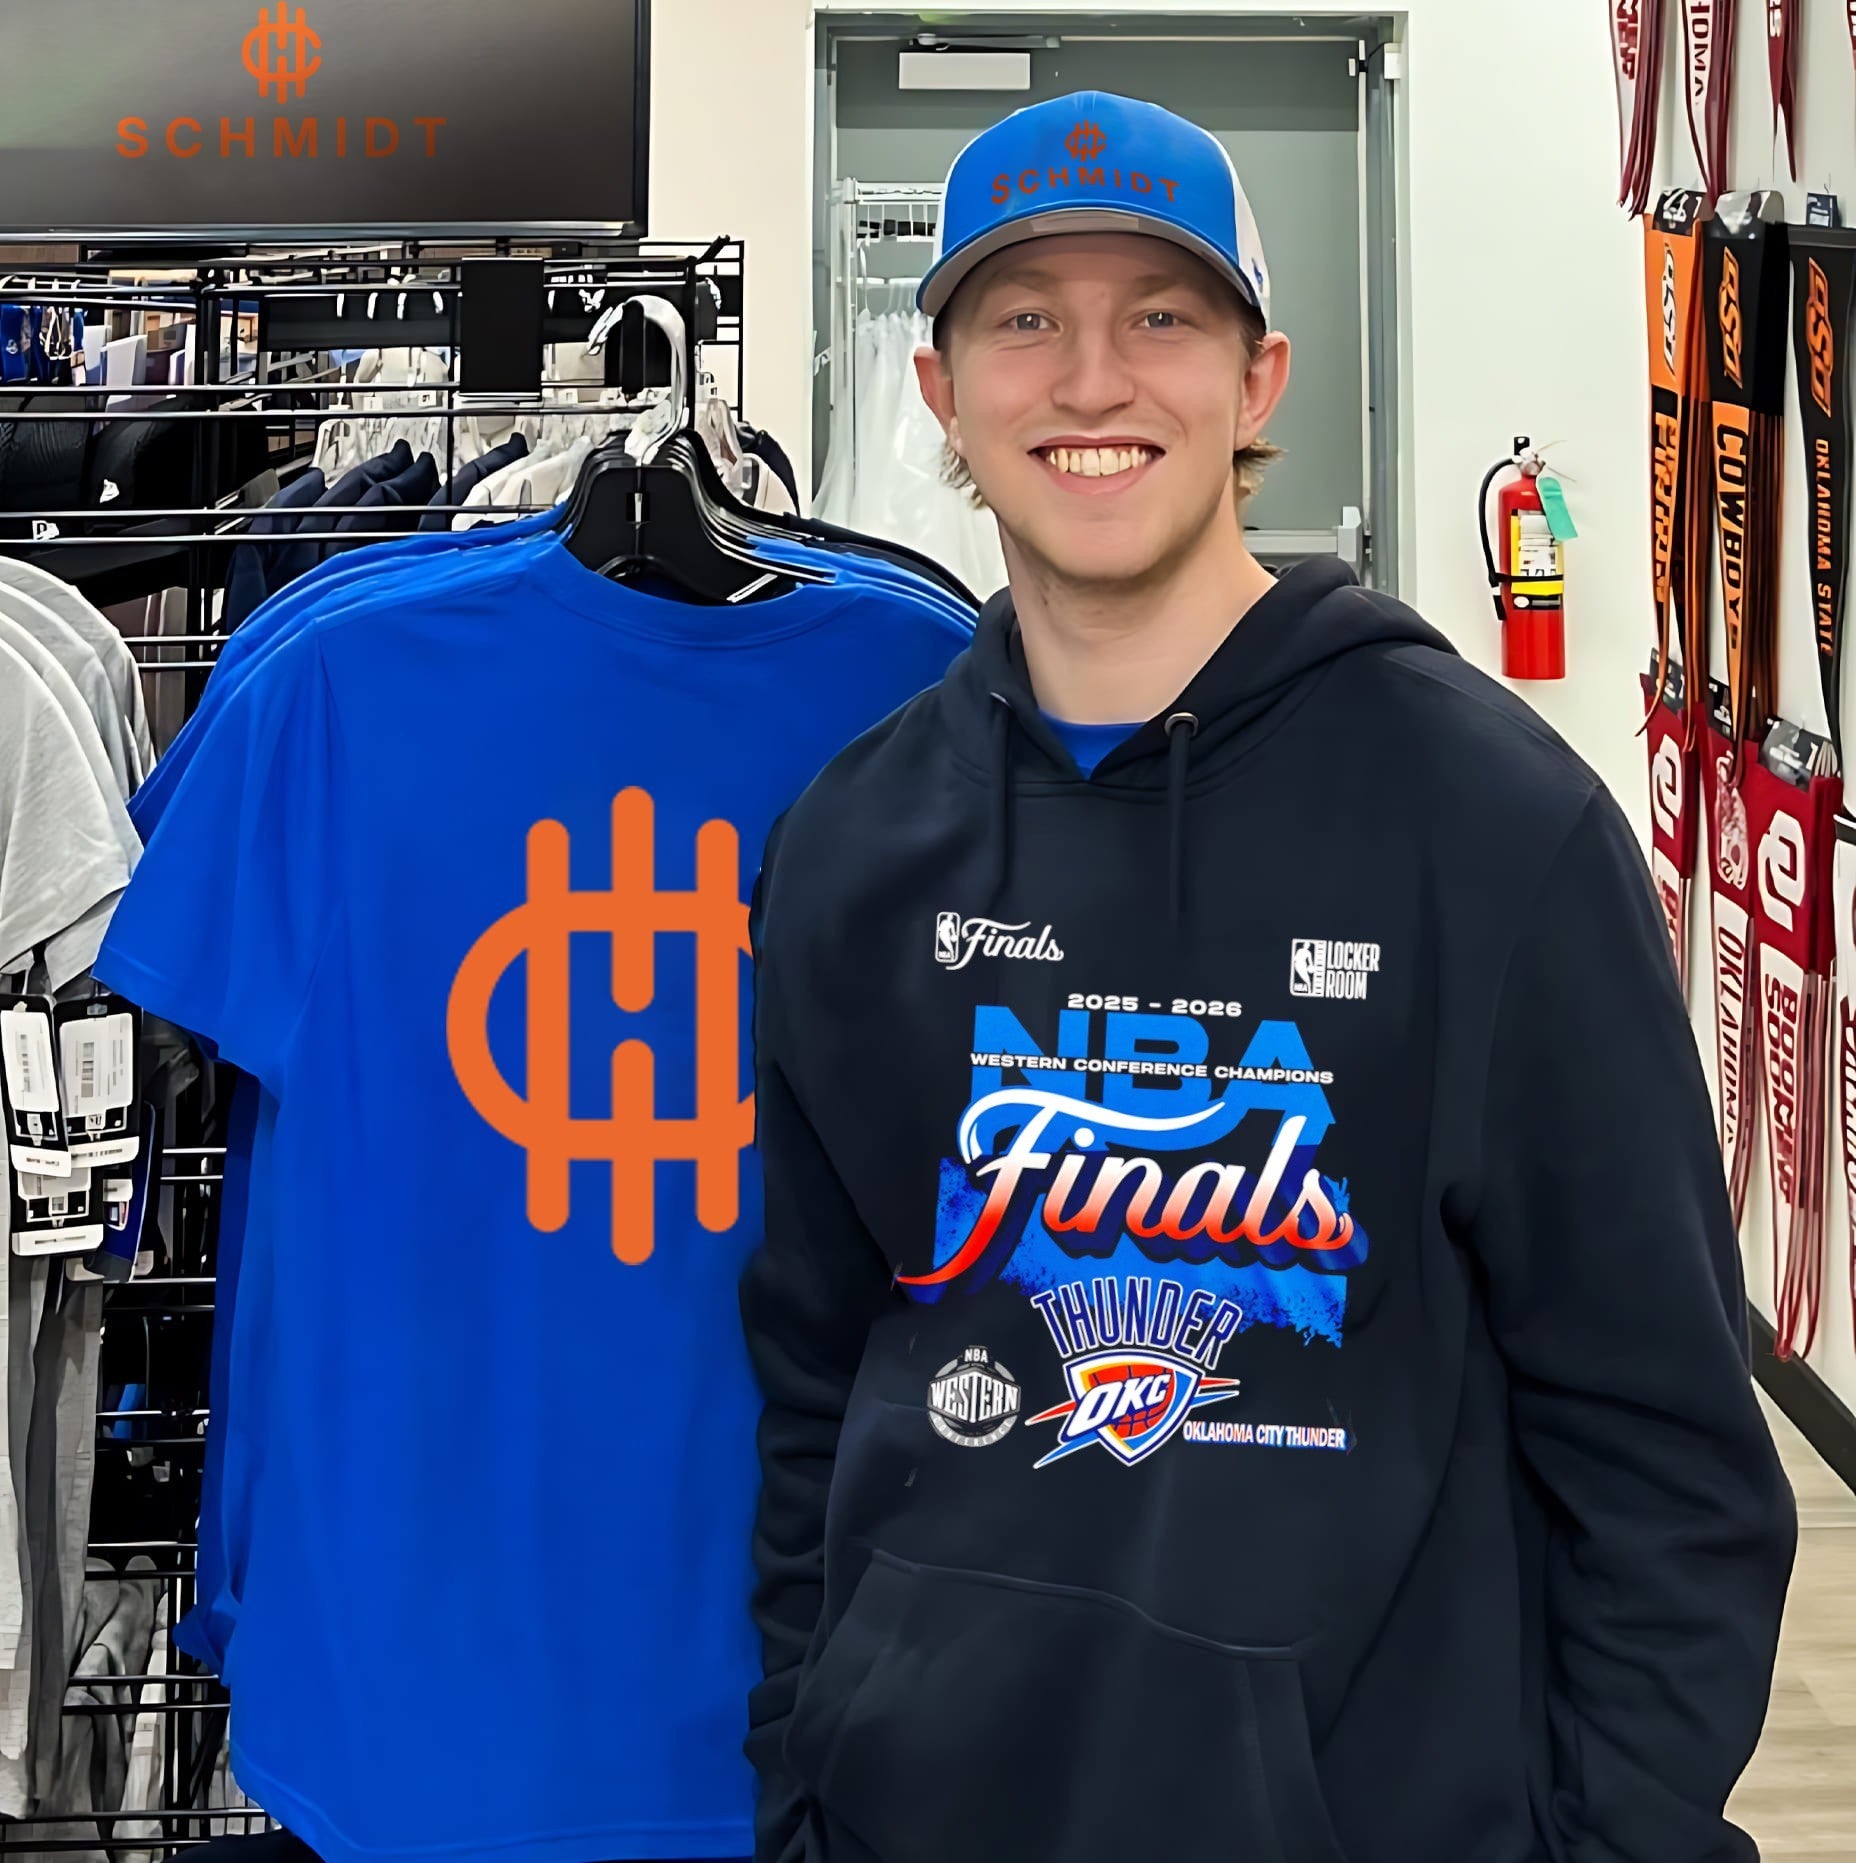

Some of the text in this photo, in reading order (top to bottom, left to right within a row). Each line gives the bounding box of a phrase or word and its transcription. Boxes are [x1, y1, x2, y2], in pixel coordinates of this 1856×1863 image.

[115, 116, 447, 159] SCHMIDT
[991, 166, 1180, 205] SCHMIDT
[946, 917, 1065, 970] Finals
[1326, 940, 1381, 972] LOCKER
[1067, 993, 1139, 1012] 2025
[1171, 999, 1243, 1017] 2026
[1325, 969, 1368, 1000] ROOM
[969, 1004, 1337, 1125] NBA
[970, 1052, 1335, 1085] WESTERN CONFERENCE CHAMPIONS
[896, 1088, 1355, 1286] Finals
[1030, 1275, 1244, 1372] THUNDER
[964, 1348, 989, 1363] NBA
[930, 1371, 1019, 1423] WESTERN
[1071, 1373, 1173, 1437] OKC
[1182, 1420, 1349, 1450] OKLAHOMA CITY THUNDER
